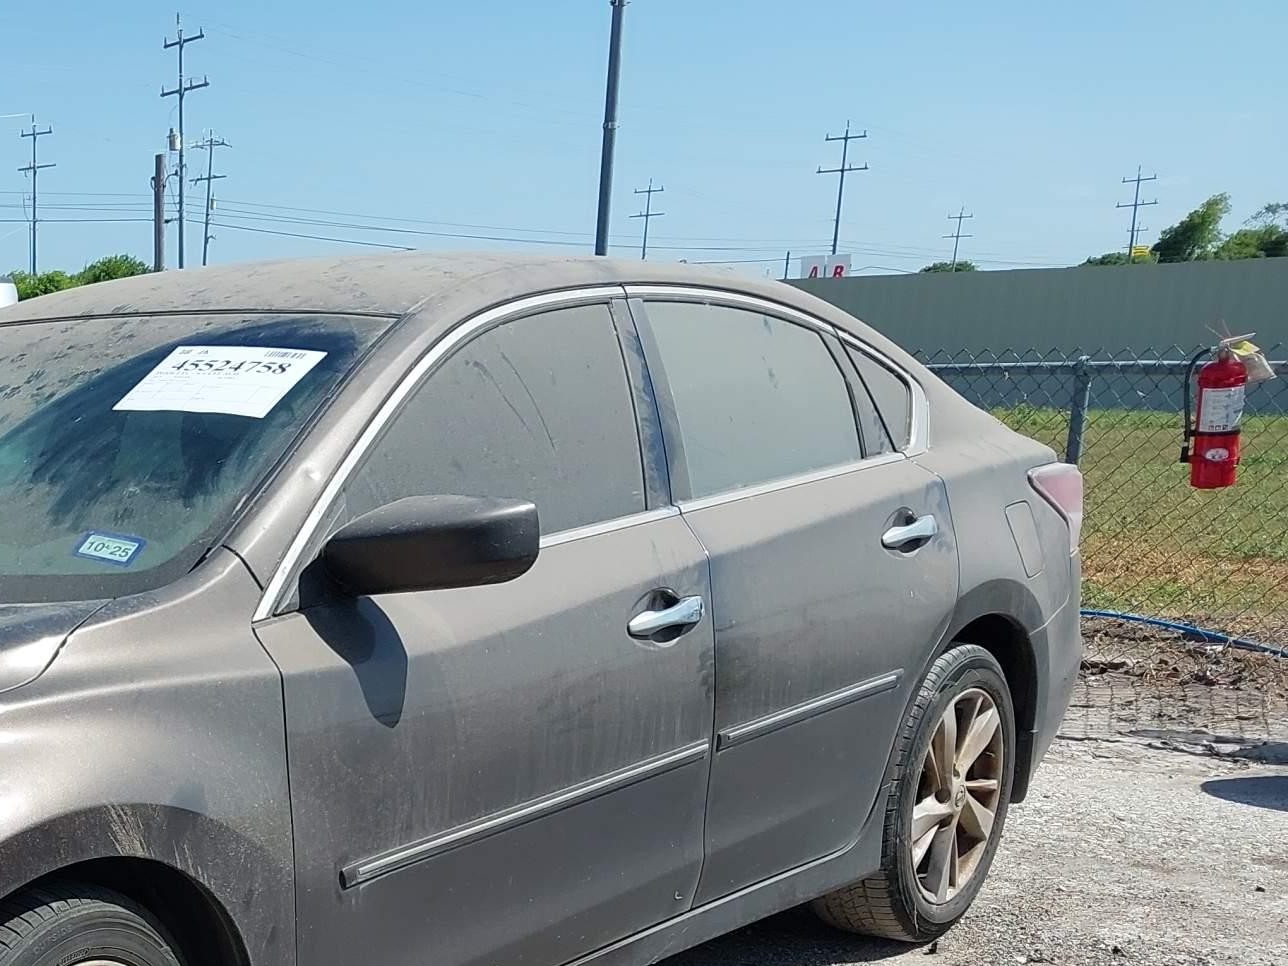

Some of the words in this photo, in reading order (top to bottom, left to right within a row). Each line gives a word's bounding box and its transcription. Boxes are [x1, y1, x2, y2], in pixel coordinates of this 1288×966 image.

[808, 265, 818, 279] A
[171, 359, 292, 375] 45524758
[109, 545, 132, 558] 25
